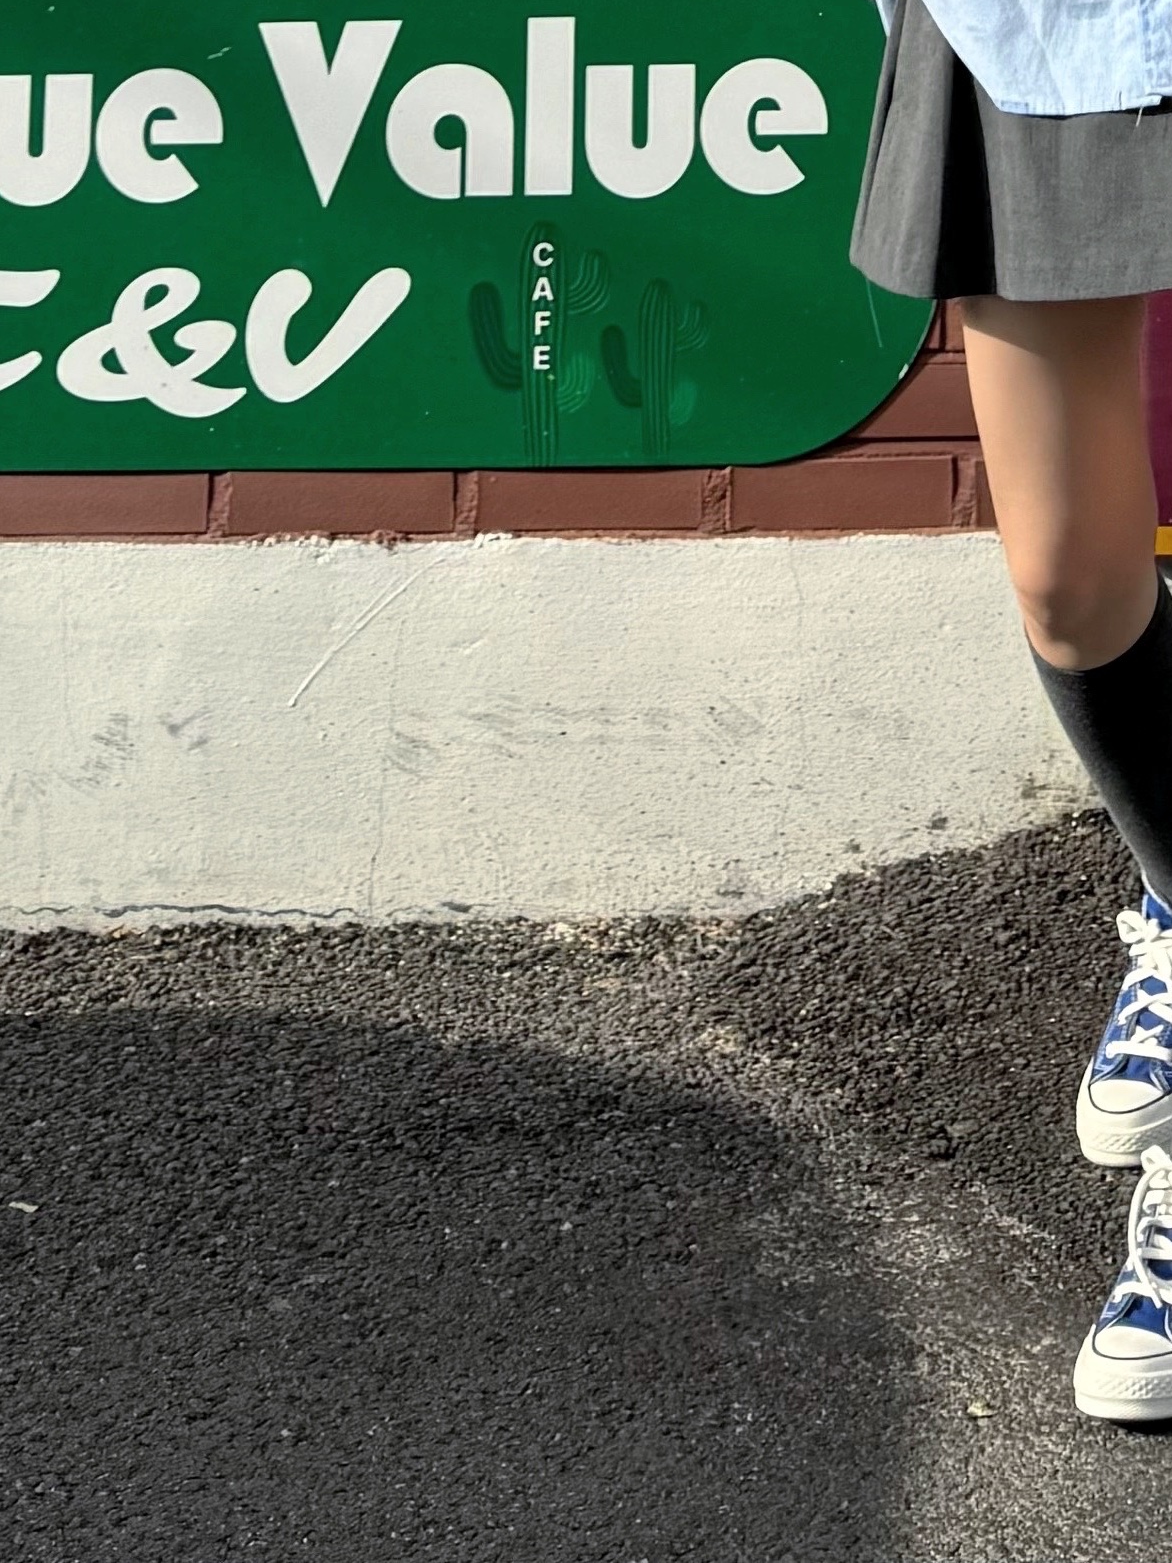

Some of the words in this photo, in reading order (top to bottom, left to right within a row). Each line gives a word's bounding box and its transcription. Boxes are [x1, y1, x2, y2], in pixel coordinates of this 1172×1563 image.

[0, 67, 224, 207] ue
[258, 16, 829, 208] Value
[531, 241, 555, 371] CAFE
